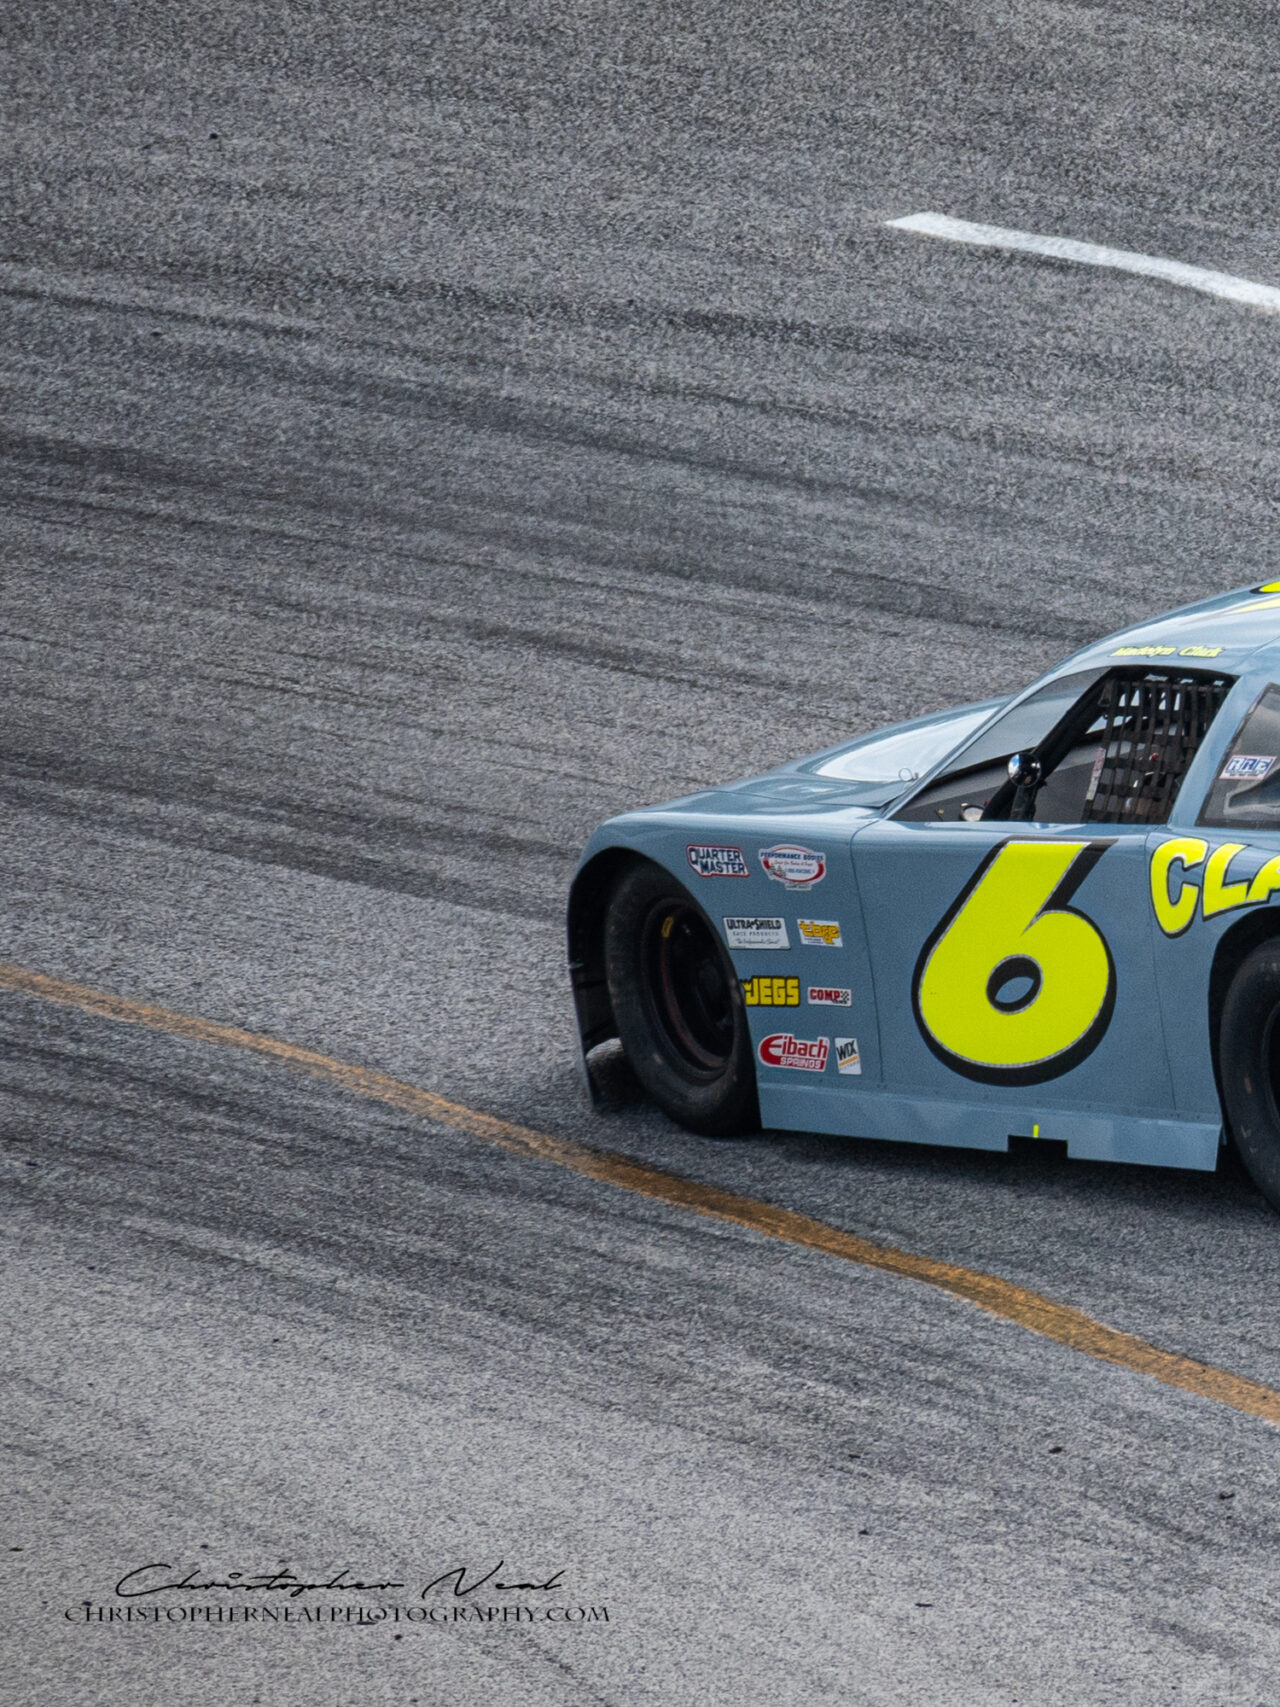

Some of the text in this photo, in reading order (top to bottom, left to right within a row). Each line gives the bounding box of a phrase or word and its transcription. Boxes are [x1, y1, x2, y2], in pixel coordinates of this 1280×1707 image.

[690, 848, 741, 865] QUARTER
[760, 851, 802, 860] PERFORMANCE
[700, 861, 746, 874] MASTER
[911, 835, 1118, 1087] 6
[744, 976, 800, 1006] JEGS
[809, 988, 841, 1001] COMP
[760, 1034, 828, 1066] Eibach
[837, 1040, 857, 1061] WIX
[780, 1056, 822, 1069] SPRINGS
